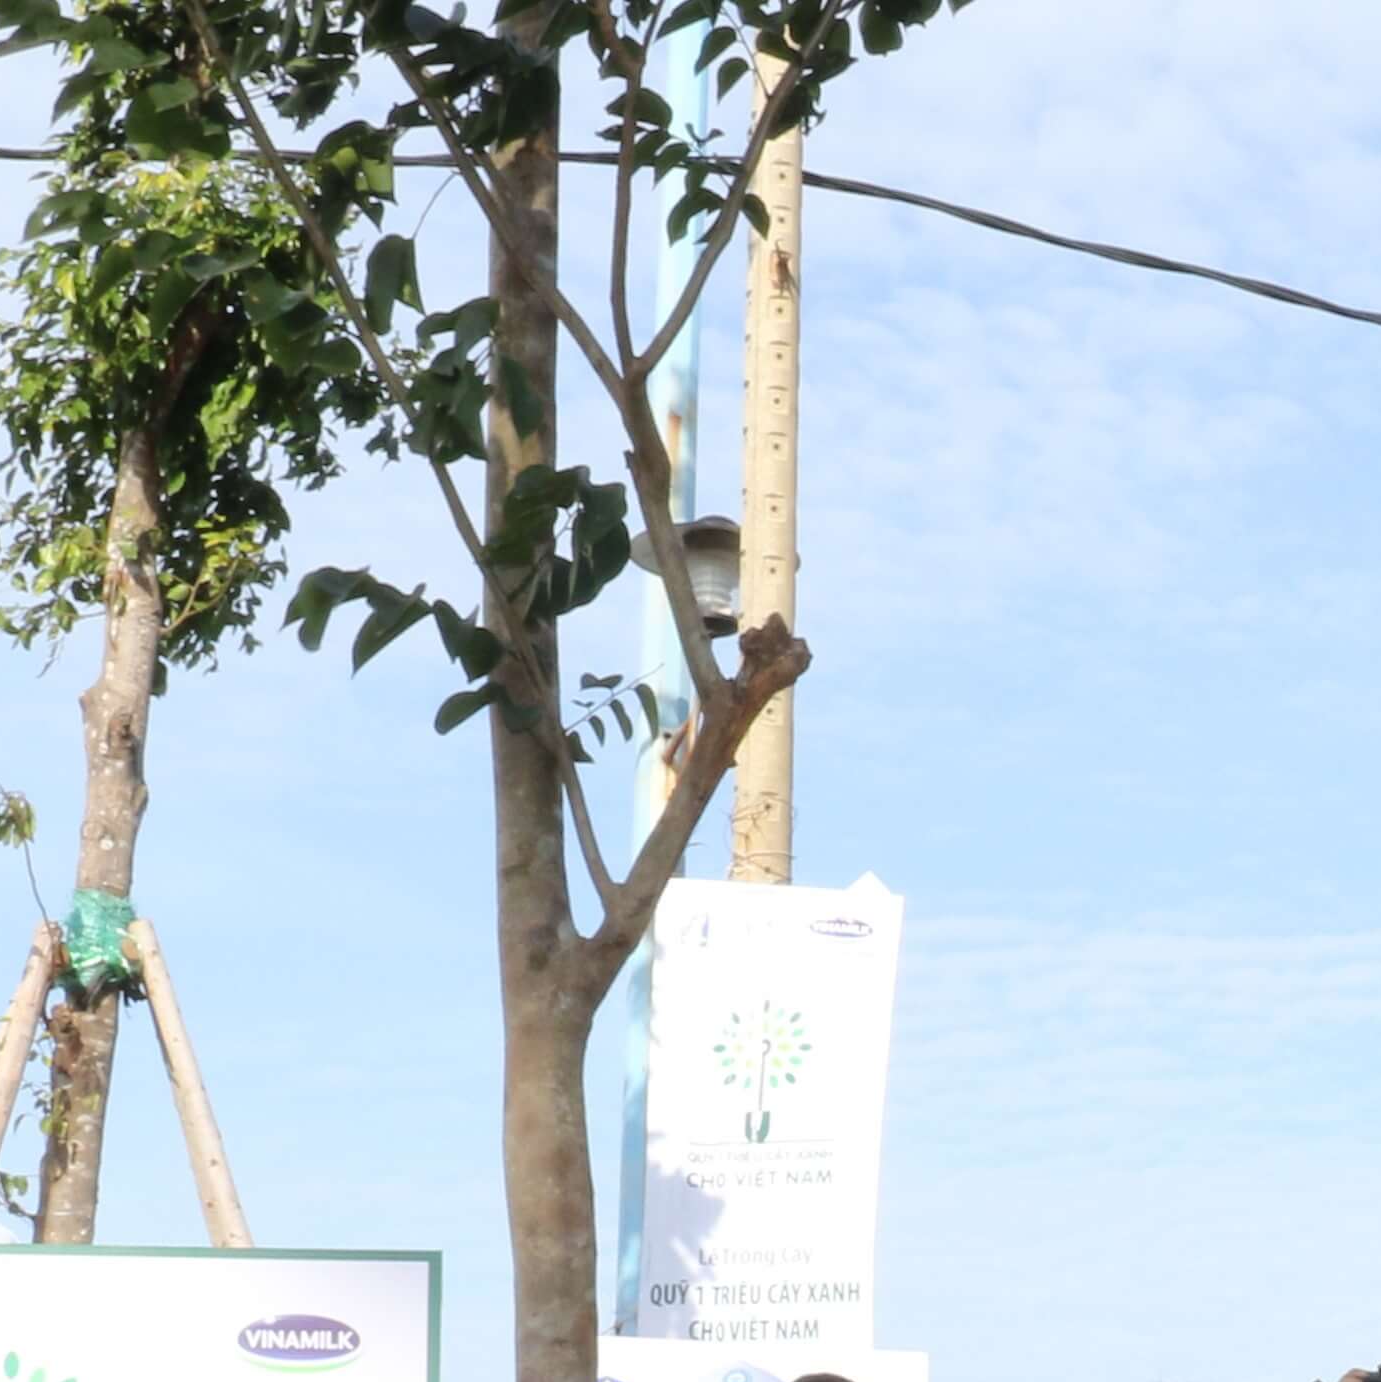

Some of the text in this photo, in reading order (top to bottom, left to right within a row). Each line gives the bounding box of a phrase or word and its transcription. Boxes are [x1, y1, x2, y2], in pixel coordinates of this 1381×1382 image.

[686, 1172, 725, 1189] CHO
[785, 1169, 833, 1185] NAM
[650, 1279, 690, 1308] QUỸ
[695, 1285, 704, 1305] 1
[807, 1281, 861, 1304] XANH
[245, 1329, 354, 1350] VINAMILK
[688, 1319, 725, 1341] CHO
[775, 1318, 820, 1340] NAM
